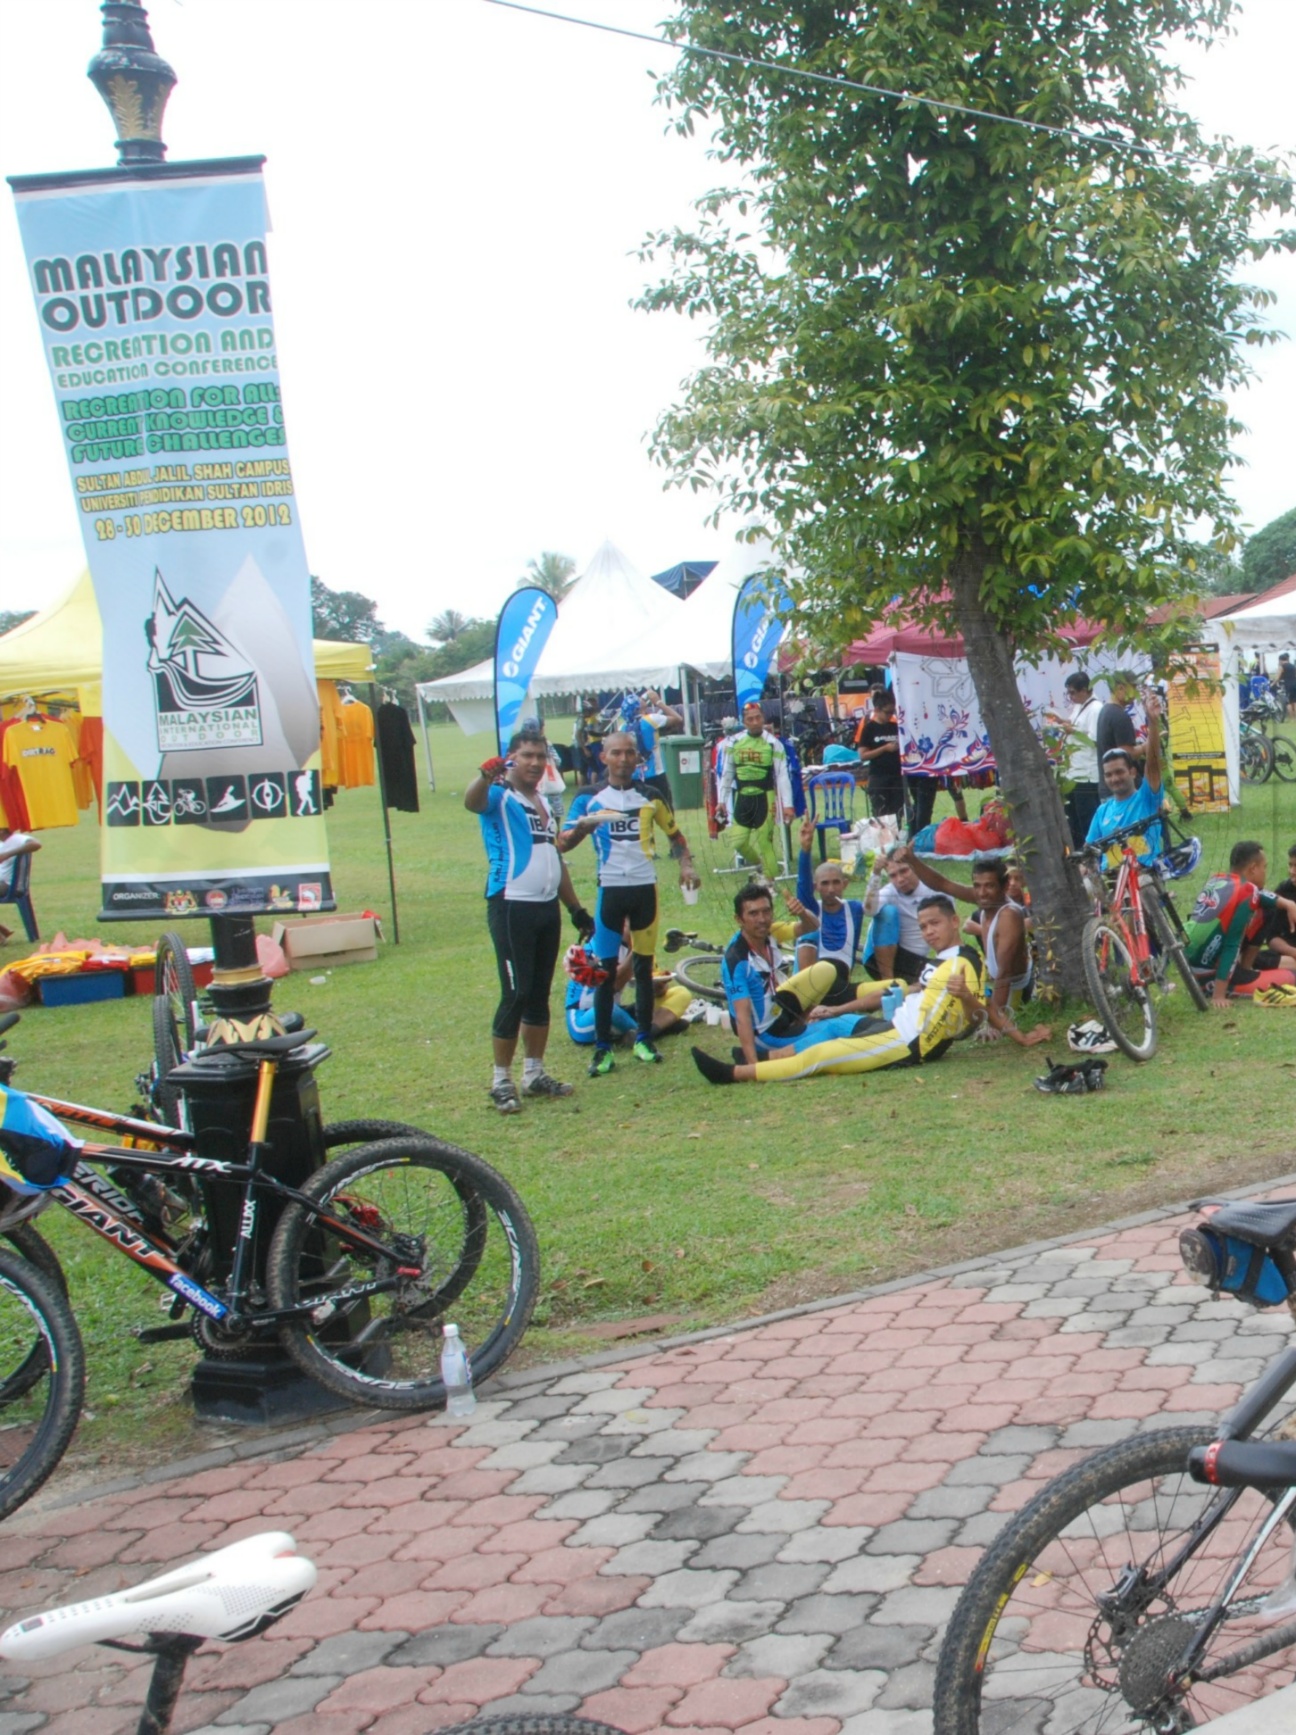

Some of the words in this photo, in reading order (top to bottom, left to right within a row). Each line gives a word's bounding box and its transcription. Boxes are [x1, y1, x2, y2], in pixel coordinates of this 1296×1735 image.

[33, 240, 268, 294] MALAYSIAN
[42, 280, 272, 332] OUTDOOR
[51, 332, 212, 368] RECREATION
[220, 327, 275, 353] AND
[57, 363, 149, 388] EDUCATION
[153, 355, 278, 377] CONFERENCE
[63, 388, 186, 421] RECREATION
[190, 384, 241, 408] FOR
[66, 415, 145, 442] CURRENT
[144, 406, 269, 432] KNOWLEDGE
[71, 437, 145, 464] FUTURE
[145, 427, 286, 453] CHALLENGES
[76, 472, 121, 493] SULTAN
[153, 464, 191, 483] JALIL
[194, 461, 233, 481] SHAH
[235, 458, 290, 478] CAMPUS
[80, 491, 138, 513] UNIVERSITI
[207, 482, 260, 500] SULTAN
[261, 479, 294, 496] IDRIS
[95, 518, 115, 540] 28
[125, 514, 142, 537] 30
[144, 507, 239, 534] DECEMBER
[241, 503, 291, 528] 2012
[511, 596, 546, 663] GIANT
[159, 708, 257, 726] MALAYSIAN
[610, 818, 640, 833] IBC
[73, 1161, 145, 1224] ERID
[51, 1187, 166, 1258] GIANT
[169, 1272, 223, 1319] facebook
